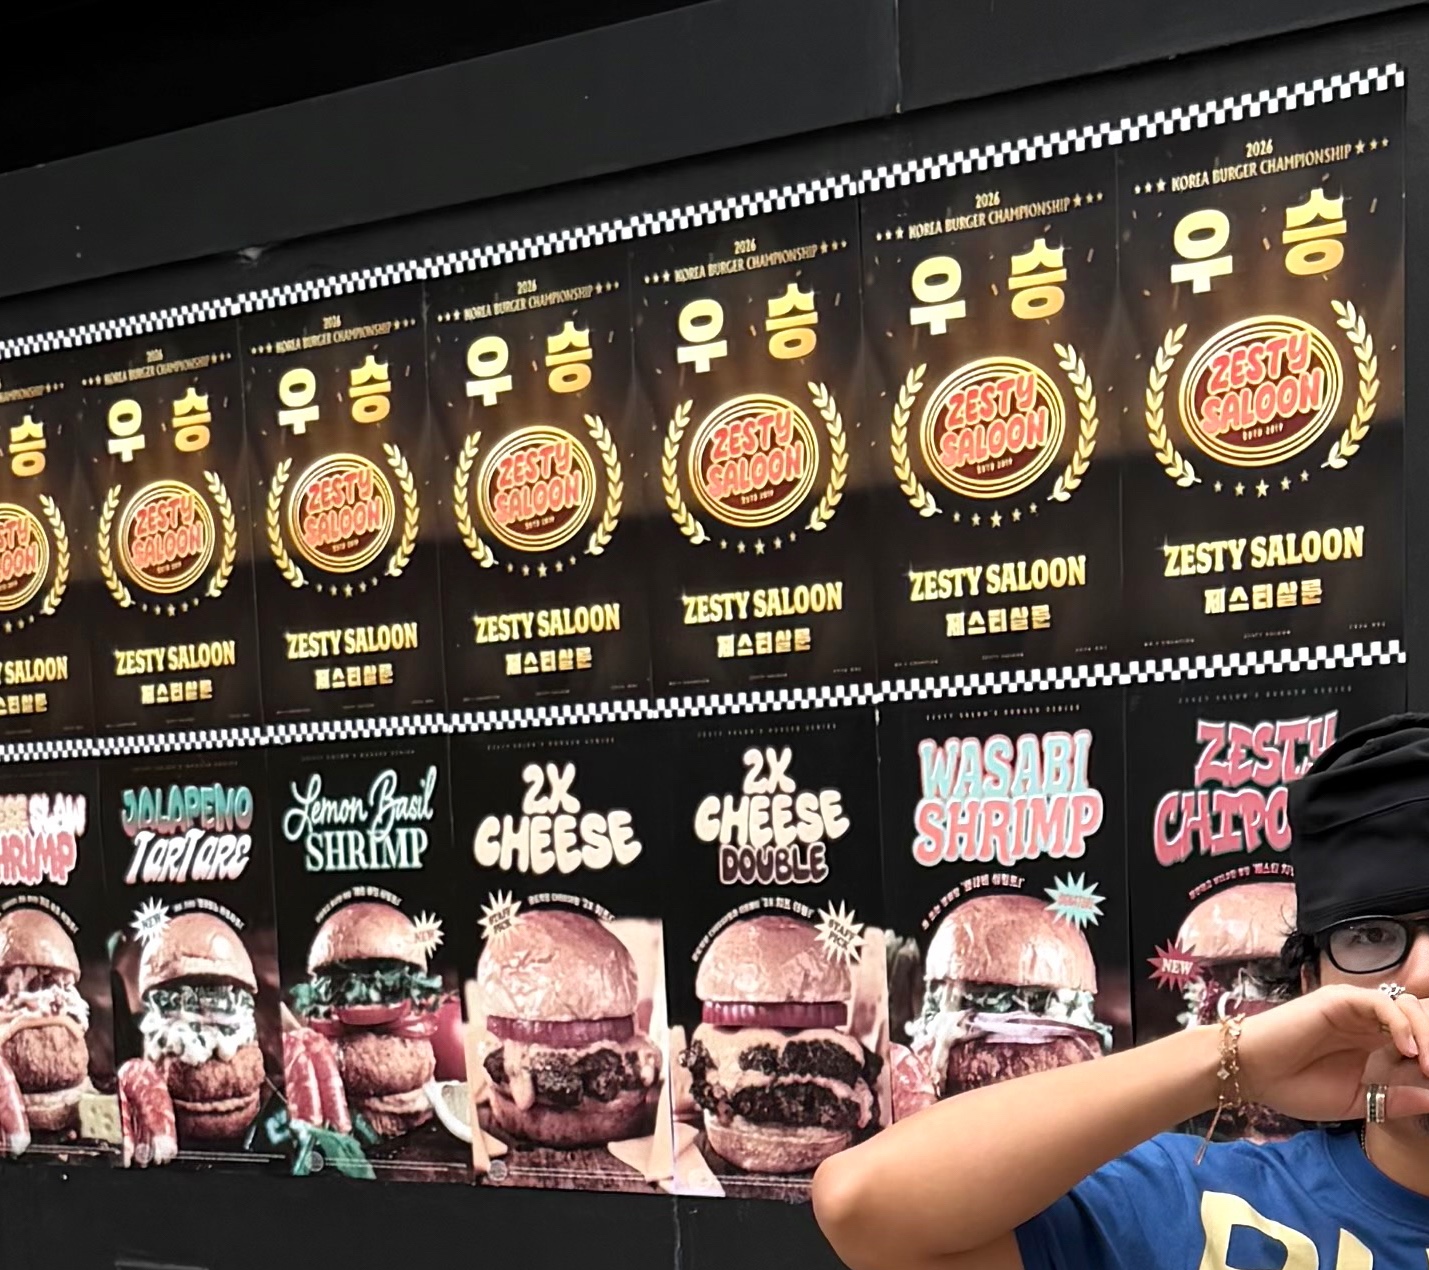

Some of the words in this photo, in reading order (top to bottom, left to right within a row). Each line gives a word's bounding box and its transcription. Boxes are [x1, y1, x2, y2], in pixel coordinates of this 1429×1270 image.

[1172, 172, 1209, 192] KOREA
[1212, 163, 1258, 184] BURGER
[1259, 144, 1352, 174] CHAMPIONSHIP
[1246, 139, 1273, 158] 2026
[975, 191, 1000, 209] 2026
[908, 221, 942, 240] KOREA
[945, 213, 985, 233] BURGER
[1208, 329, 1311, 395] ZESTY
[945, 372, 1038, 430] ZESTY
[1200, 367, 1324, 434] SALOON
[9, 415, 46, 477] 승
[710, 407, 796, 463] ZESTY
[938, 406, 1048, 468] SALOON
[305, 466, 374, 513] ZESTY
[498, 438, 573, 491] ZESTY
[706, 440, 804, 500] SALOON
[135, 493, 195, 538] ZESTY
[302, 495, 382, 549] SALOON
[493, 470, 583, 527] SALOON
[131, 520, 204, 571] SALOON
[1163, 538, 1246, 577] ZESTY
[1251, 526, 1364, 568] SALOON
[683, 591, 750, 625] ZESTY
[754, 581, 843, 618] SALOON
[910, 565, 983, 601] ZESTY
[987, 555, 1086, 594] SALOON
[286, 629, 341, 660] ZESTY
[344, 621, 418, 655] SALOON
[475, 611, 534, 643] ZESTY
[537, 602, 620, 637] SALOON
[4, 655, 68, 685] SALOON
[115, 647, 165, 676] ZESTY
[168, 640, 235, 672] SALOON
[522, 762, 581, 815] 2X
[742, 747, 796, 794] 2X
[919, 728, 1092, 799] WASABI
[283, 773, 368, 841] Lemon
[369, 765, 437, 842] Basil
[694, 790, 850, 847] CHEESE
[912, 788, 1103, 867] SHRIMP
[1153, 787, 1292, 867] CHIPO
[305, 827, 428, 872] SHRIMP
[473, 810, 642, 874] CHEESE
[719, 842, 829, 885] DOUBLE
[141, 913, 163, 931] NEW
[1161, 957, 1193, 975] NEW
